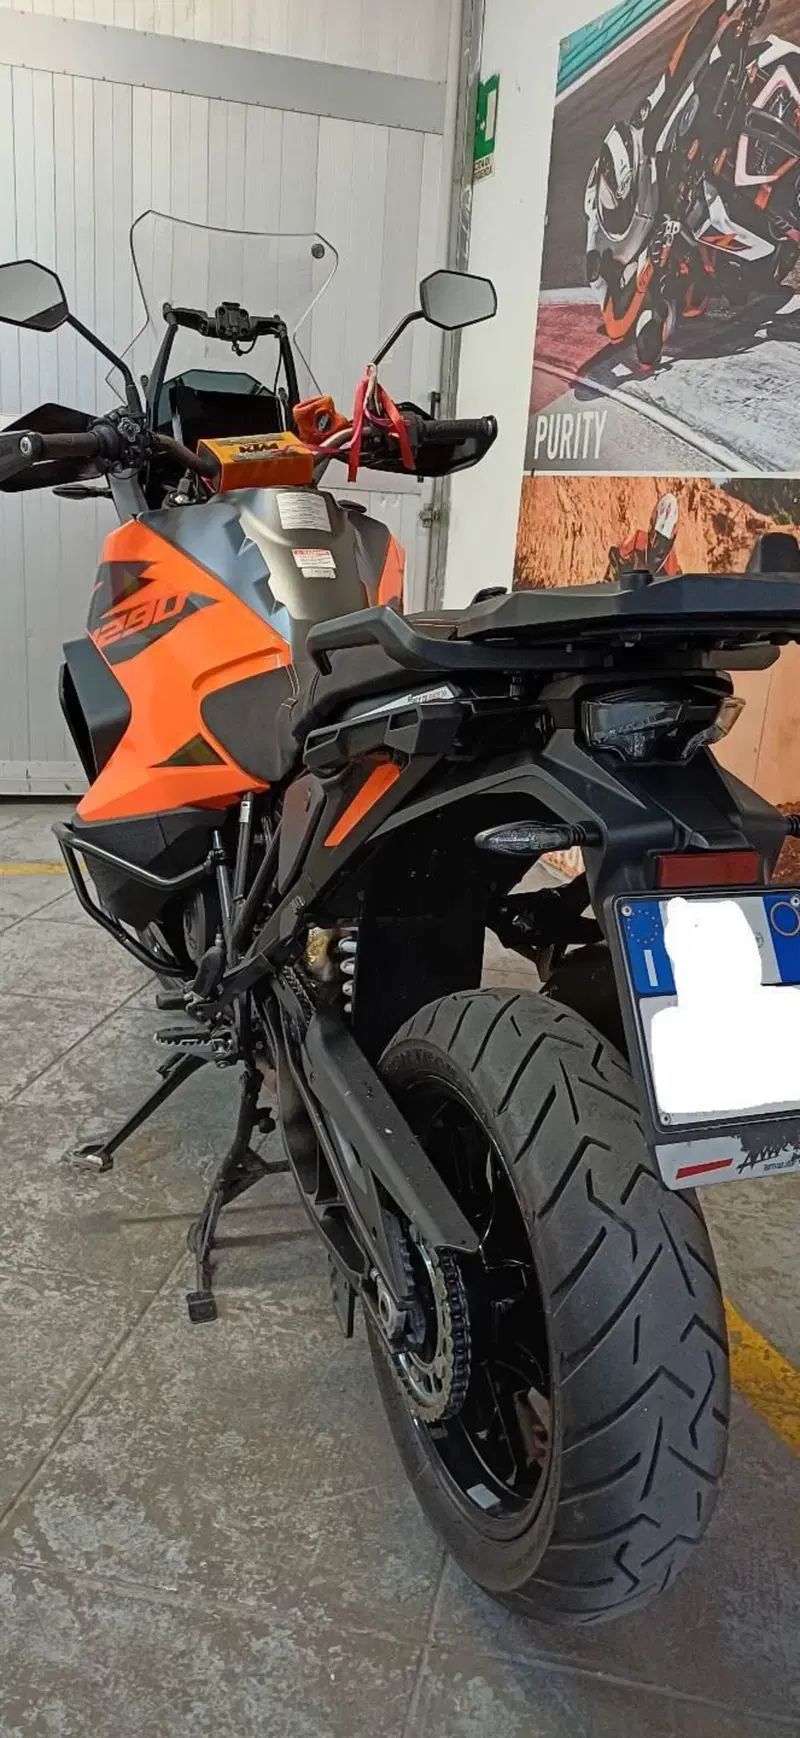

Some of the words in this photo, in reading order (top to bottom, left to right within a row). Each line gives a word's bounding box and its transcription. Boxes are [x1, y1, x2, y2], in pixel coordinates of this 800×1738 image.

[239, 443, 279, 453] KTM
[534, 410, 608, 460] PURITY
[91, 593, 186, 649] 1290
